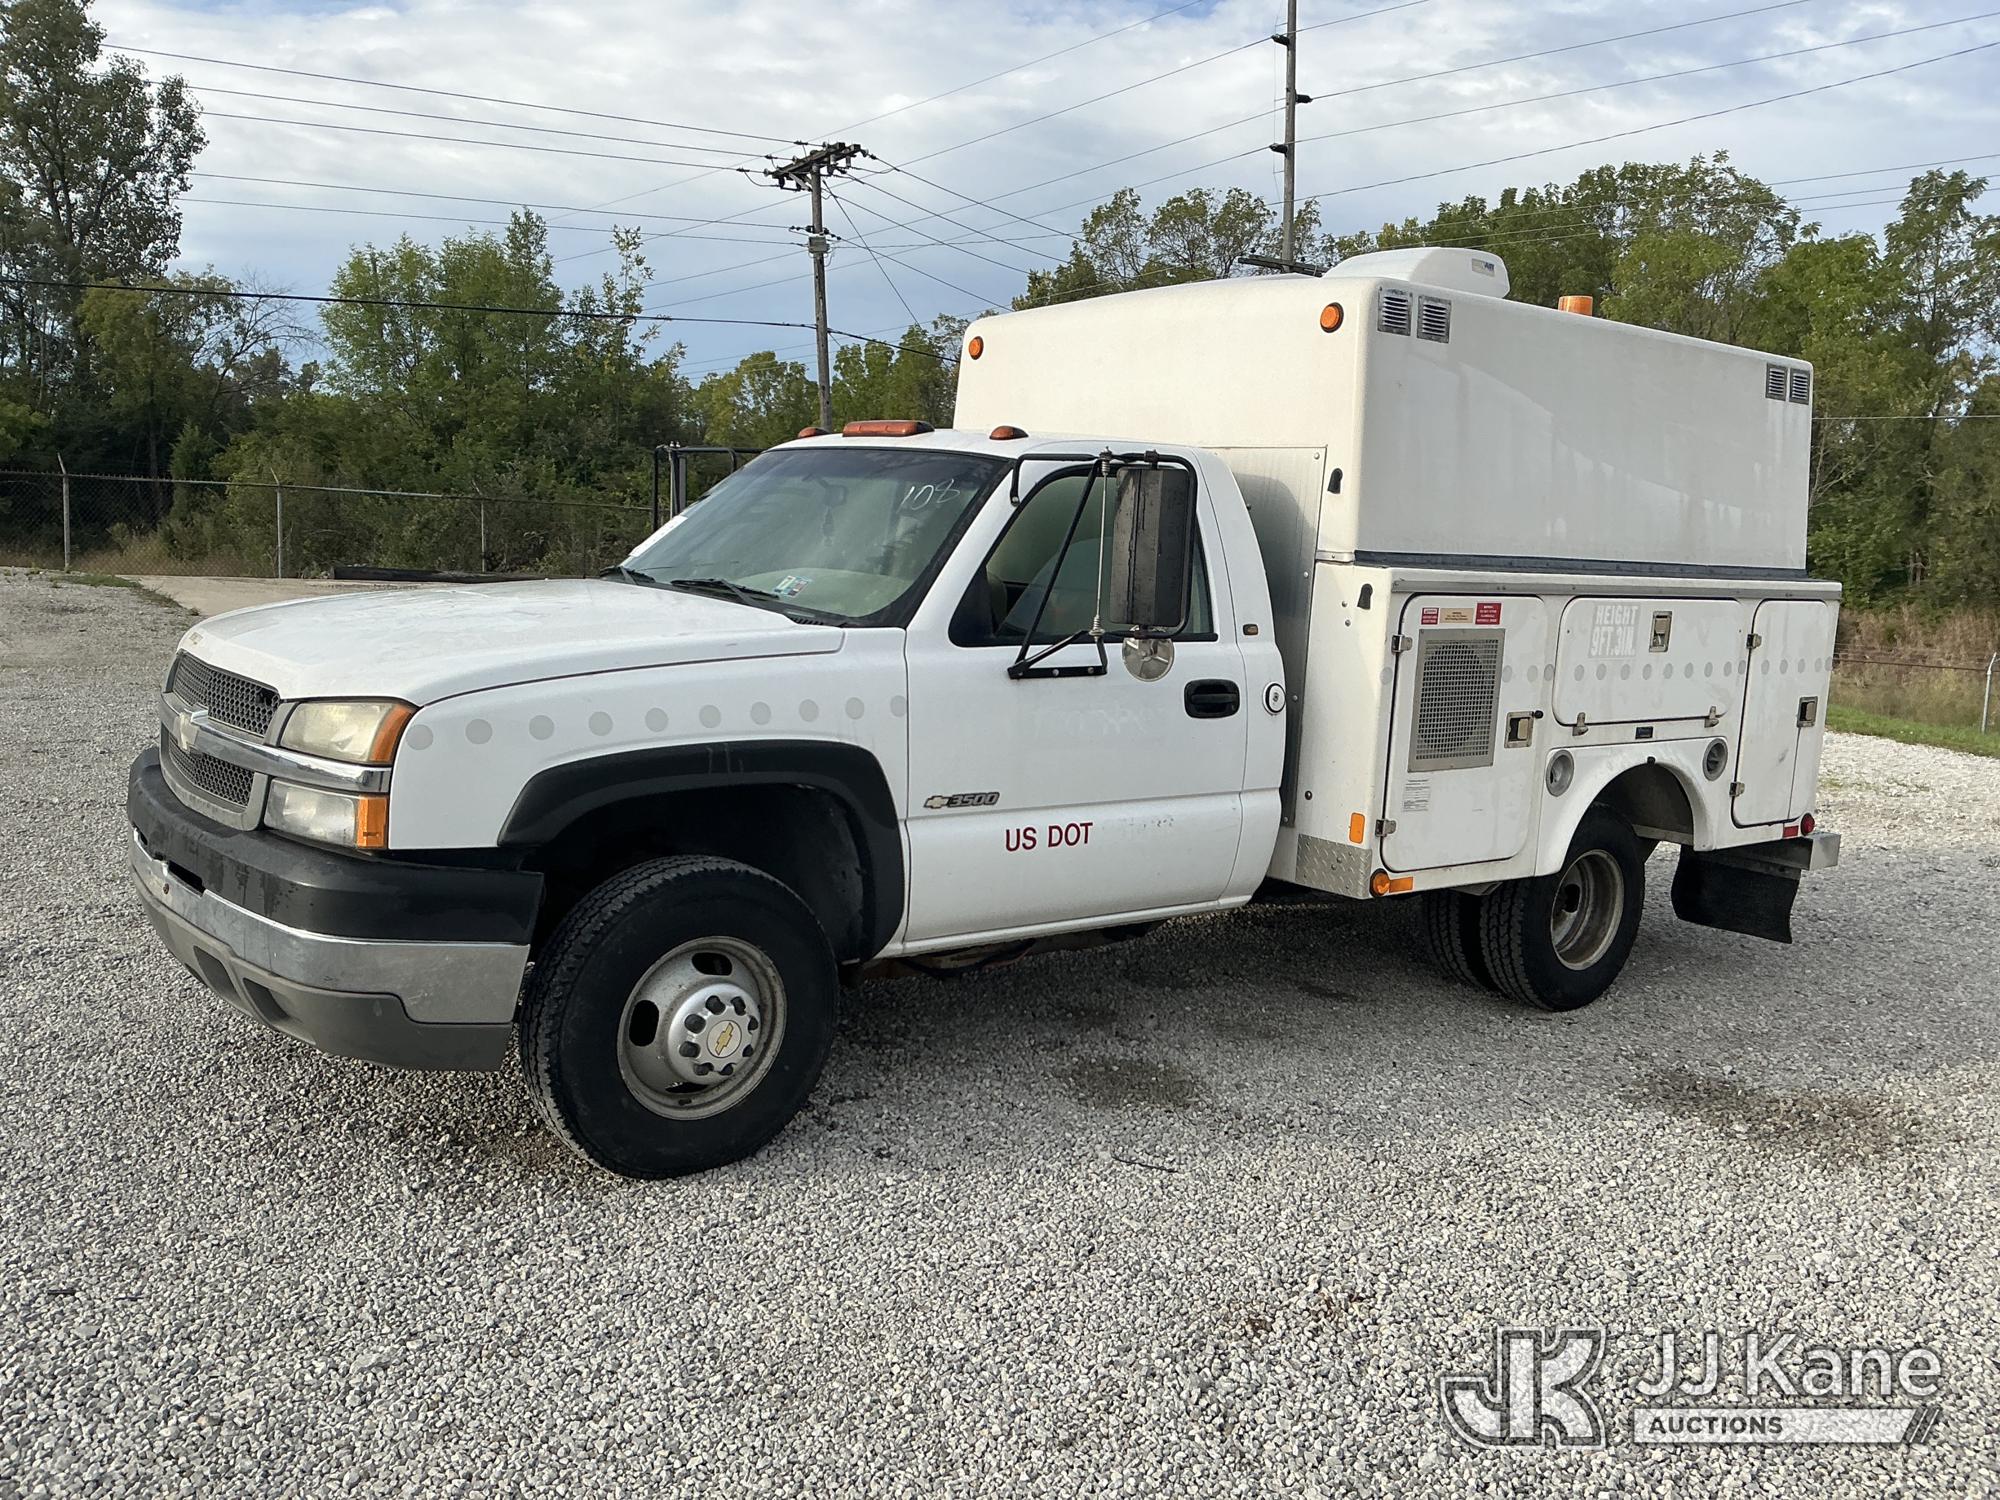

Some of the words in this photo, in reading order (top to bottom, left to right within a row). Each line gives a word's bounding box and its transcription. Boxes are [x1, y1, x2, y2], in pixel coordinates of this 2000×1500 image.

[896, 479, 960, 514] 108
[1595, 605, 1639, 625] HEIGHT
[948, 792, 1000, 807] 3500
[1005, 827, 1037, 852] US
[1048, 822, 1094, 848] DOT
